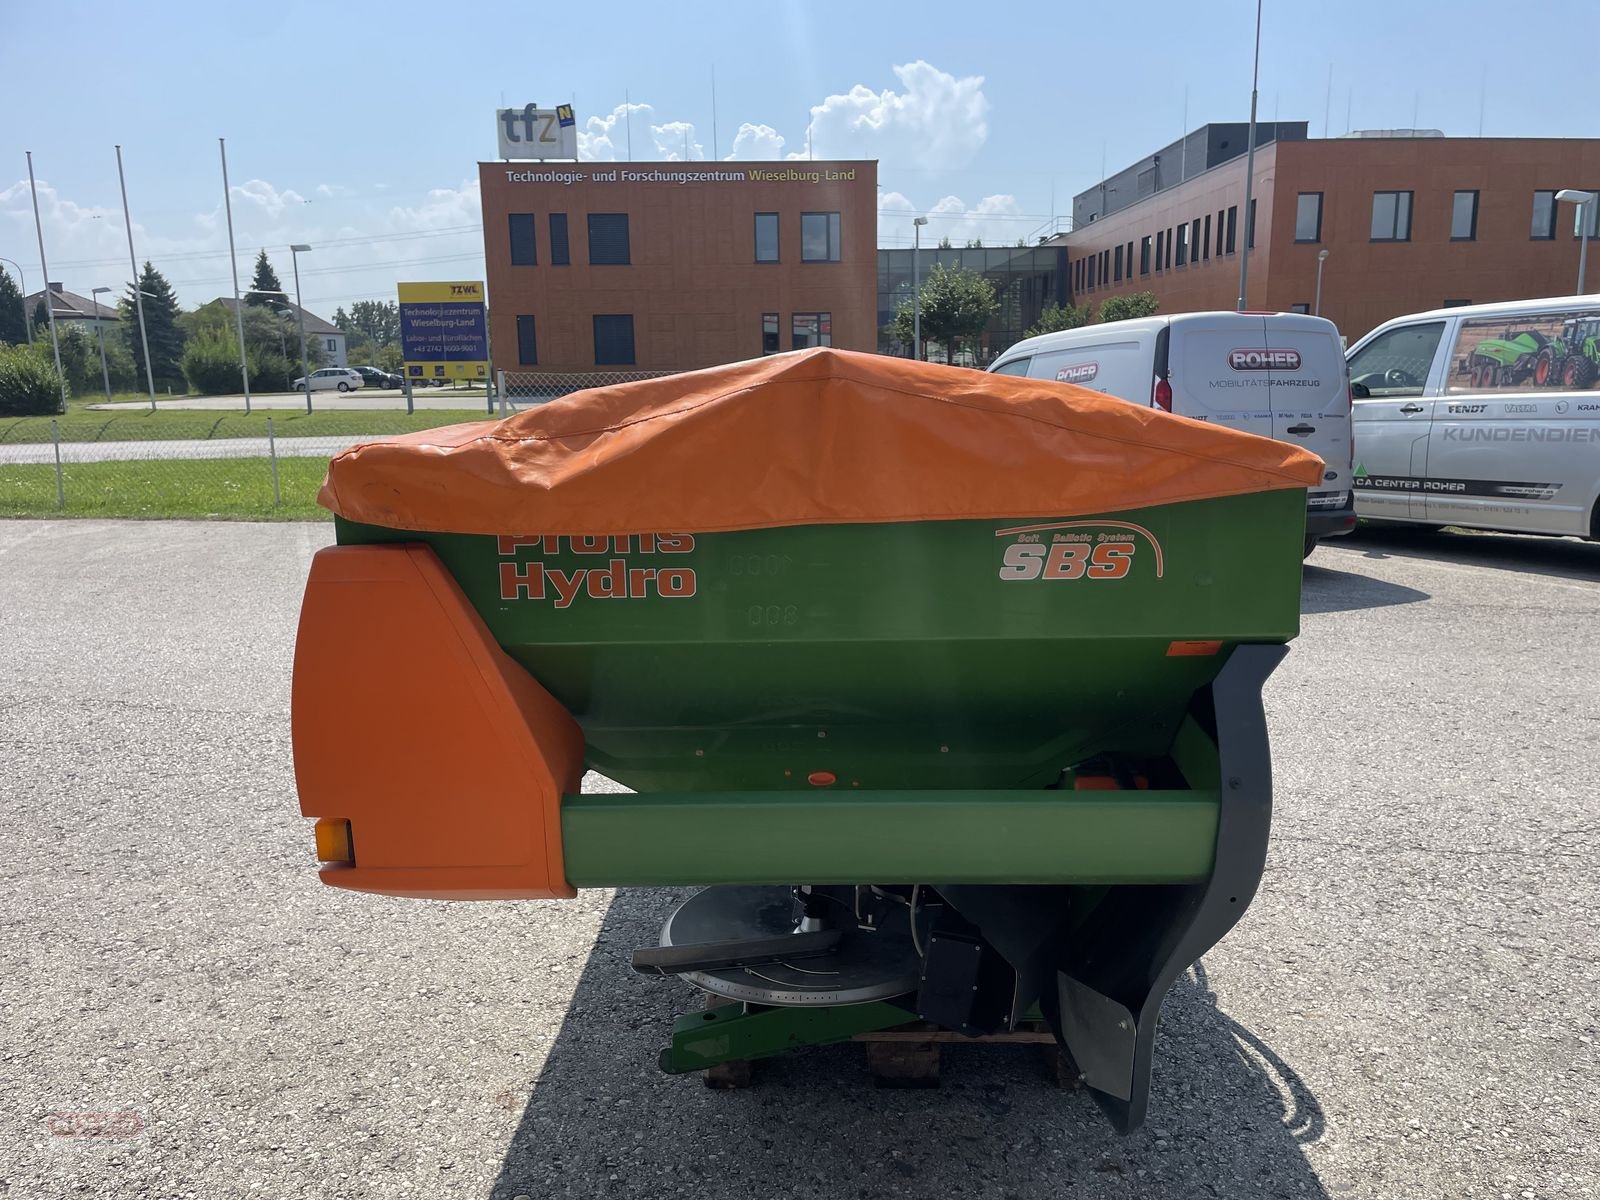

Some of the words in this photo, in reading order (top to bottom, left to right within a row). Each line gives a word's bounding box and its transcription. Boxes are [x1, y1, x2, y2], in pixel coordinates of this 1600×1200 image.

[501, 102, 557, 143] tfz
[505, 170, 587, 185] Technologie-
[592, 170, 616, 182] und
[621, 169, 745, 185] Forschungszentrum
[749, 169, 855, 183] Wieselburg-Land
[410, 318, 475, 328] Wieselburg-Land
[1232, 352, 1299, 368] ROHER
[1209, 378, 1320, 389] MOBILITÄTSFAHRZEUG
[1448, 404, 1488, 414] FENDT
[1374, 479, 1420, 489] CENTER
[1423, 481, 1466, 492] ROHER
[1017, 534, 1040, 543] Soft
[1052, 533, 1092, 542] Ballistic
[1097, 532, 1135, 543] System
[999, 542, 1136, 580] SBS
[499, 559, 697, 608] Hydro
